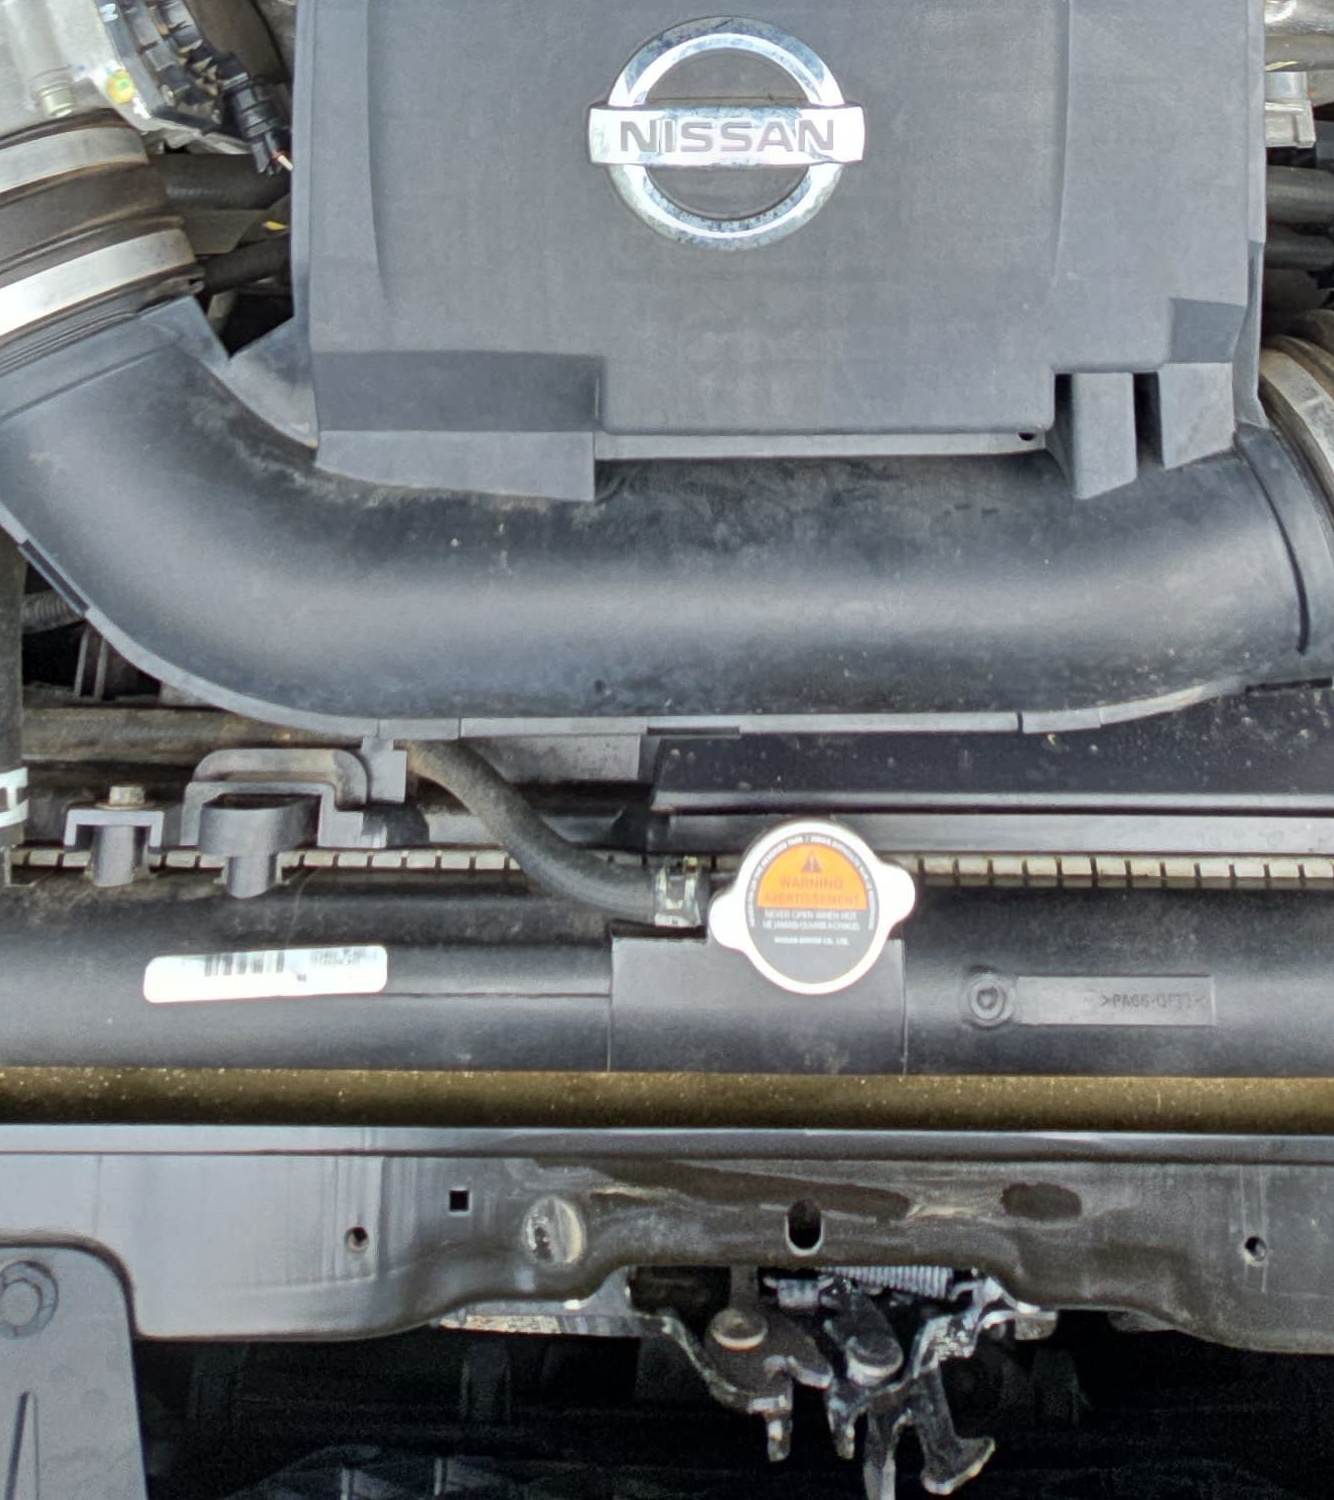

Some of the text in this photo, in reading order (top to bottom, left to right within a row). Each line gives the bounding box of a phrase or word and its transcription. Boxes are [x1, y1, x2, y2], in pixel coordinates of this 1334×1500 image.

[619, 116, 836, 155] NISSAN
[779, 876, 844, 890] WARNING
[766, 894, 860, 905] AVERTISSEMENT
[765, 910, 857, 920] NEVER OPEN WHEN HOT
